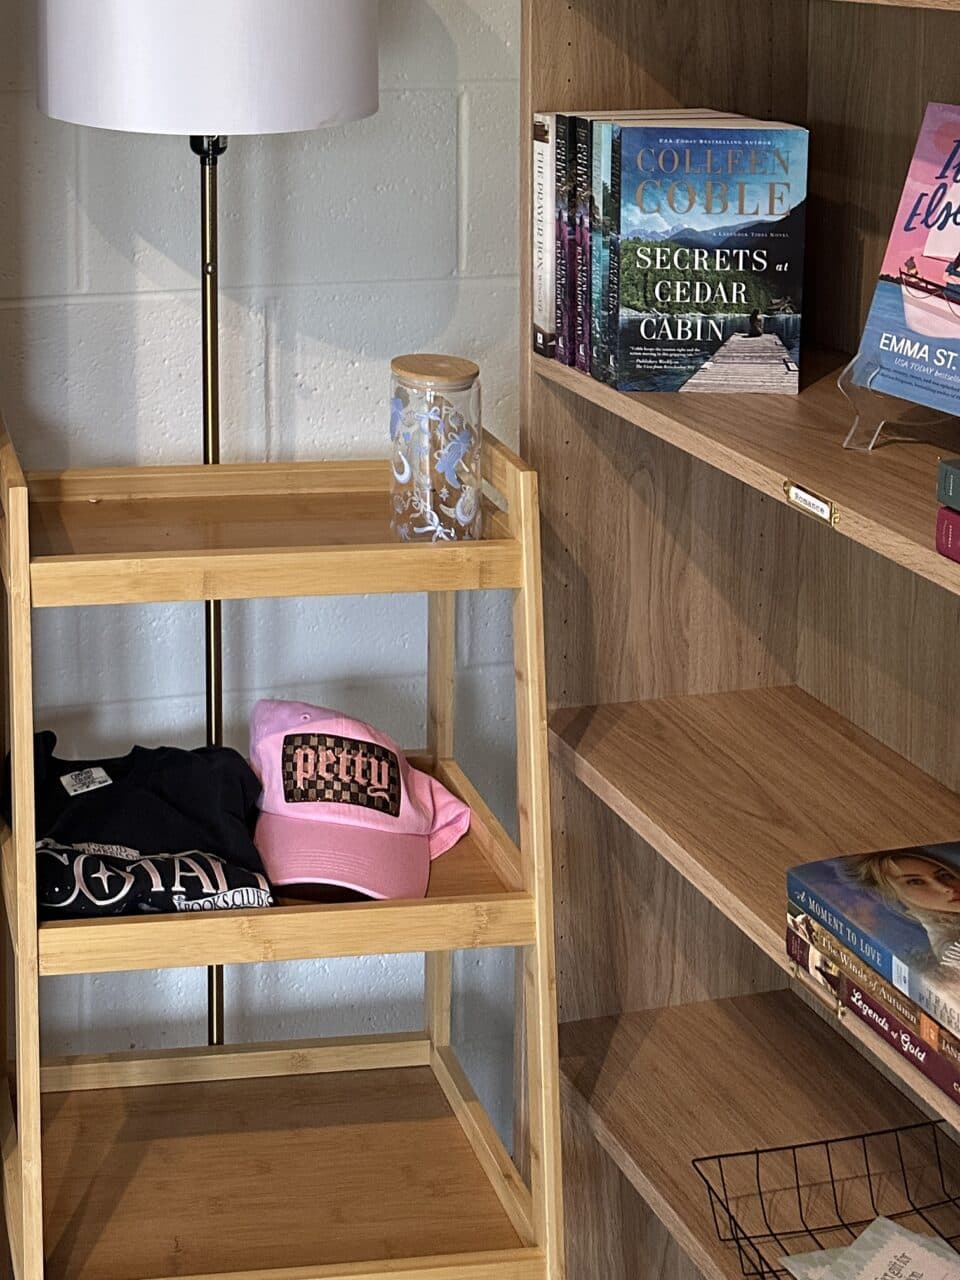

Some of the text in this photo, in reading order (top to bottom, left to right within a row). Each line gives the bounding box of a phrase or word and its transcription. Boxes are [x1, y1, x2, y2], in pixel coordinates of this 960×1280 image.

[636, 148, 792, 176] COLLEEN
[635, 180, 791, 216] COBLE
[636, 247, 789, 272] SECRETS at
[654, 280, 748, 304] CEDAR
[640, 318, 726, 341] CABIN
[879, 332, 958, 370] EMMA ST.
[794, 491, 825, 514] Romance
[293, 745, 392, 801] petty
[808, 897, 845, 935] MOMENT
[846, 923, 858, 947] TO
[860, 938, 883, 968] LOVE
[820, 937, 837, 955] The
[840, 954, 868, 983] Winds
[879, 984, 919, 1025] Autumn
[851, 987, 890, 1032] Legends
